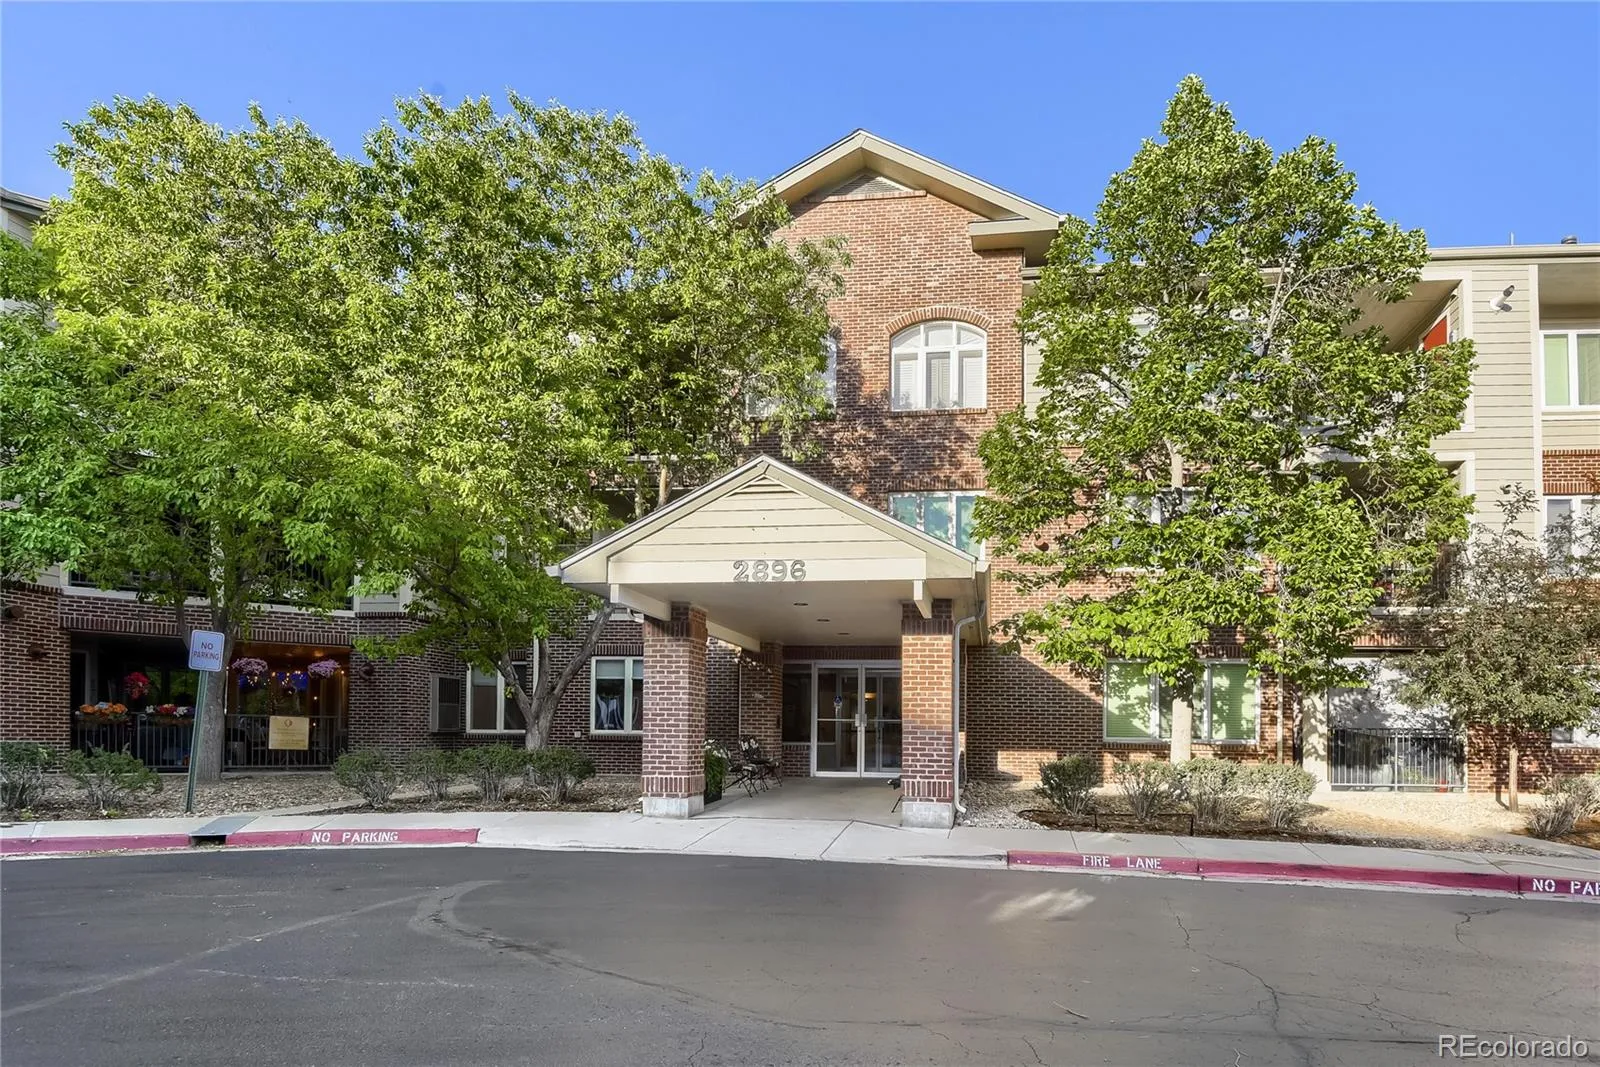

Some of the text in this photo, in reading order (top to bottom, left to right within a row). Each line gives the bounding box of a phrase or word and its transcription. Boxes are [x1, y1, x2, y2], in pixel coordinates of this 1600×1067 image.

[733, 560, 806, 582] 2896
[201, 642, 213, 650] NO
[193, 651, 219, 660] PARKING
[311, 832, 399, 843] NO PARKING
[1082, 855, 1162, 869] FIRE LANE
[1532, 878, 1556, 892] NO
